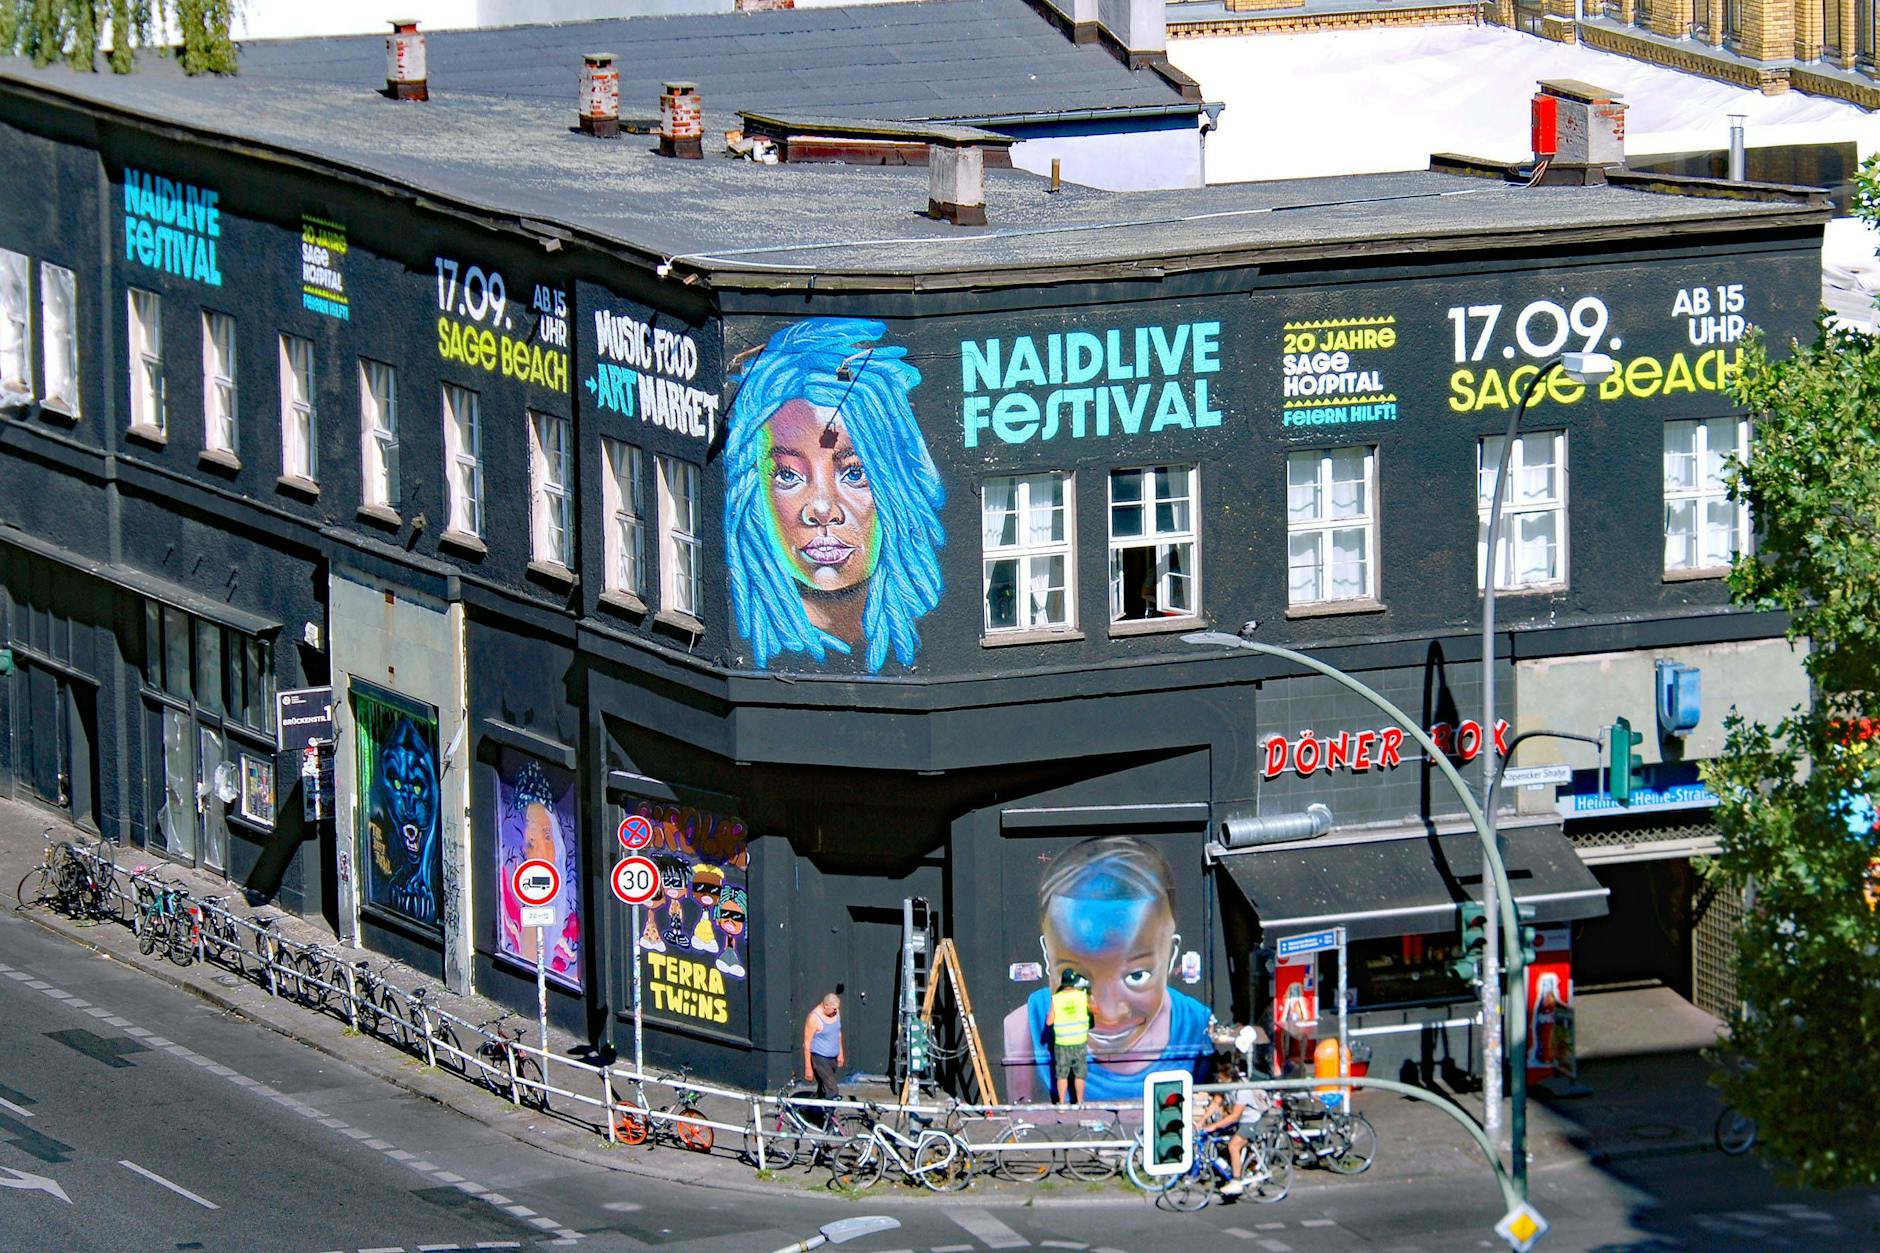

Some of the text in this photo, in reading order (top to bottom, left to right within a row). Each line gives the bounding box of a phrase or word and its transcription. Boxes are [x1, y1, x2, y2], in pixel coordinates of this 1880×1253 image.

[124, 166, 220, 238] NAIDLIVE
[302, 242, 330, 268] SAGe
[303, 262, 343, 292] HOSPITAL
[435, 256, 512, 330] 17.09.
[533, 284, 567, 318] AB 15
[1671, 284, 1745, 318] AB 15
[540, 314, 568, 348] UHR
[595, 310, 698, 381] MUSIC FOOD
[1283, 327, 1396, 354] 20 JAHRe
[1448, 296, 1622, 363] 17.09.
[1688, 315, 1745, 346] UHR
[438, 317, 567, 393] SAGe BeACH
[961, 321, 1221, 392] NAIDLIVE
[1282, 351, 1350, 376] SAGe
[1283, 370, 1384, 397] HOSPITAL
[1449, 365, 1586, 412] SAGe
[597, 363, 719, 445] ART MARKET
[1283, 403, 1397, 427] FeIeRN HILFT!
[323, 704, 332, 721] 1
[1264, 727, 1403, 777] DÖNER
[623, 870, 649, 890] 30
[647, 951, 726, 995] TERRA
